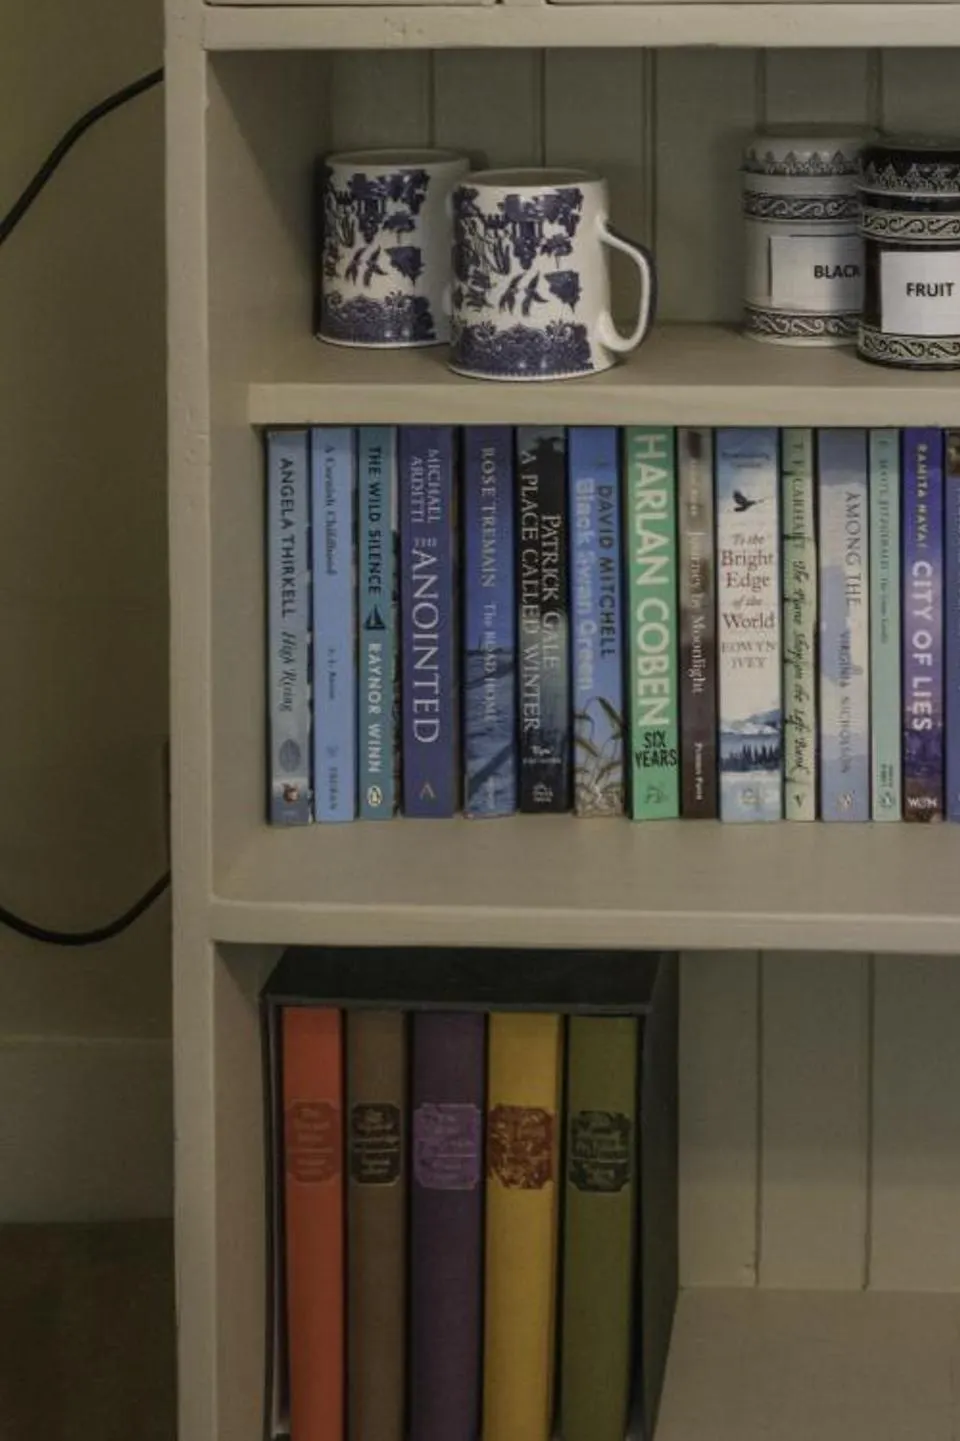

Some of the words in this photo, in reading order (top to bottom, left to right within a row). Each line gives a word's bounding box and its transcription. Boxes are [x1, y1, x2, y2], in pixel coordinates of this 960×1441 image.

[906, 282, 954, 297] FRUIT
[367, 446, 382, 478] THE
[409, 456, 425, 524] ARDITTI
[427, 448, 442, 524] MICHAEL
[480, 447, 496, 496] ROSE
[521, 450, 538, 465] A
[279, 458, 295, 530] ANGELA
[367, 483, 382, 523] WILD
[521, 474, 539, 540] PLACE
[575, 478, 595, 544] Black
[598, 484, 615, 549] DAVID
[633, 433, 670, 585] HARLAN
[480, 502, 496, 588] TREMAIN
[541, 514, 562, 601] PATRICK
[721, 549, 773, 571] Bright
[844, 491, 862, 566] AMONG
[280, 534, 296, 617] THIRKELL
[367, 529, 383, 595] SILENCE
[521, 549, 539, 635] CALLED
[576, 551, 595, 615] Swan
[726, 572, 770, 593] Edge
[845, 573, 863, 607] THE
[911, 560, 933, 621] CITY
[599, 556, 616, 658] MITCHELL
[722, 611, 775, 629] World
[280, 631, 297, 666] High
[411, 549, 440, 743] ANOINTED
[542, 611, 562, 669] GALE
[577, 620, 595, 691] Green
[636, 598, 670, 728] COBEN
[687, 614, 706, 694] Moonlight
[912, 629, 933, 666] OF
[366, 642, 382, 714] RAYNOR
[522, 645, 541, 732] WINTER
[911, 677, 933, 732] LIES
[366, 723, 382, 773] WINN
[635, 748, 677, 768] YEARS
[644, 731, 667, 749] SIX
